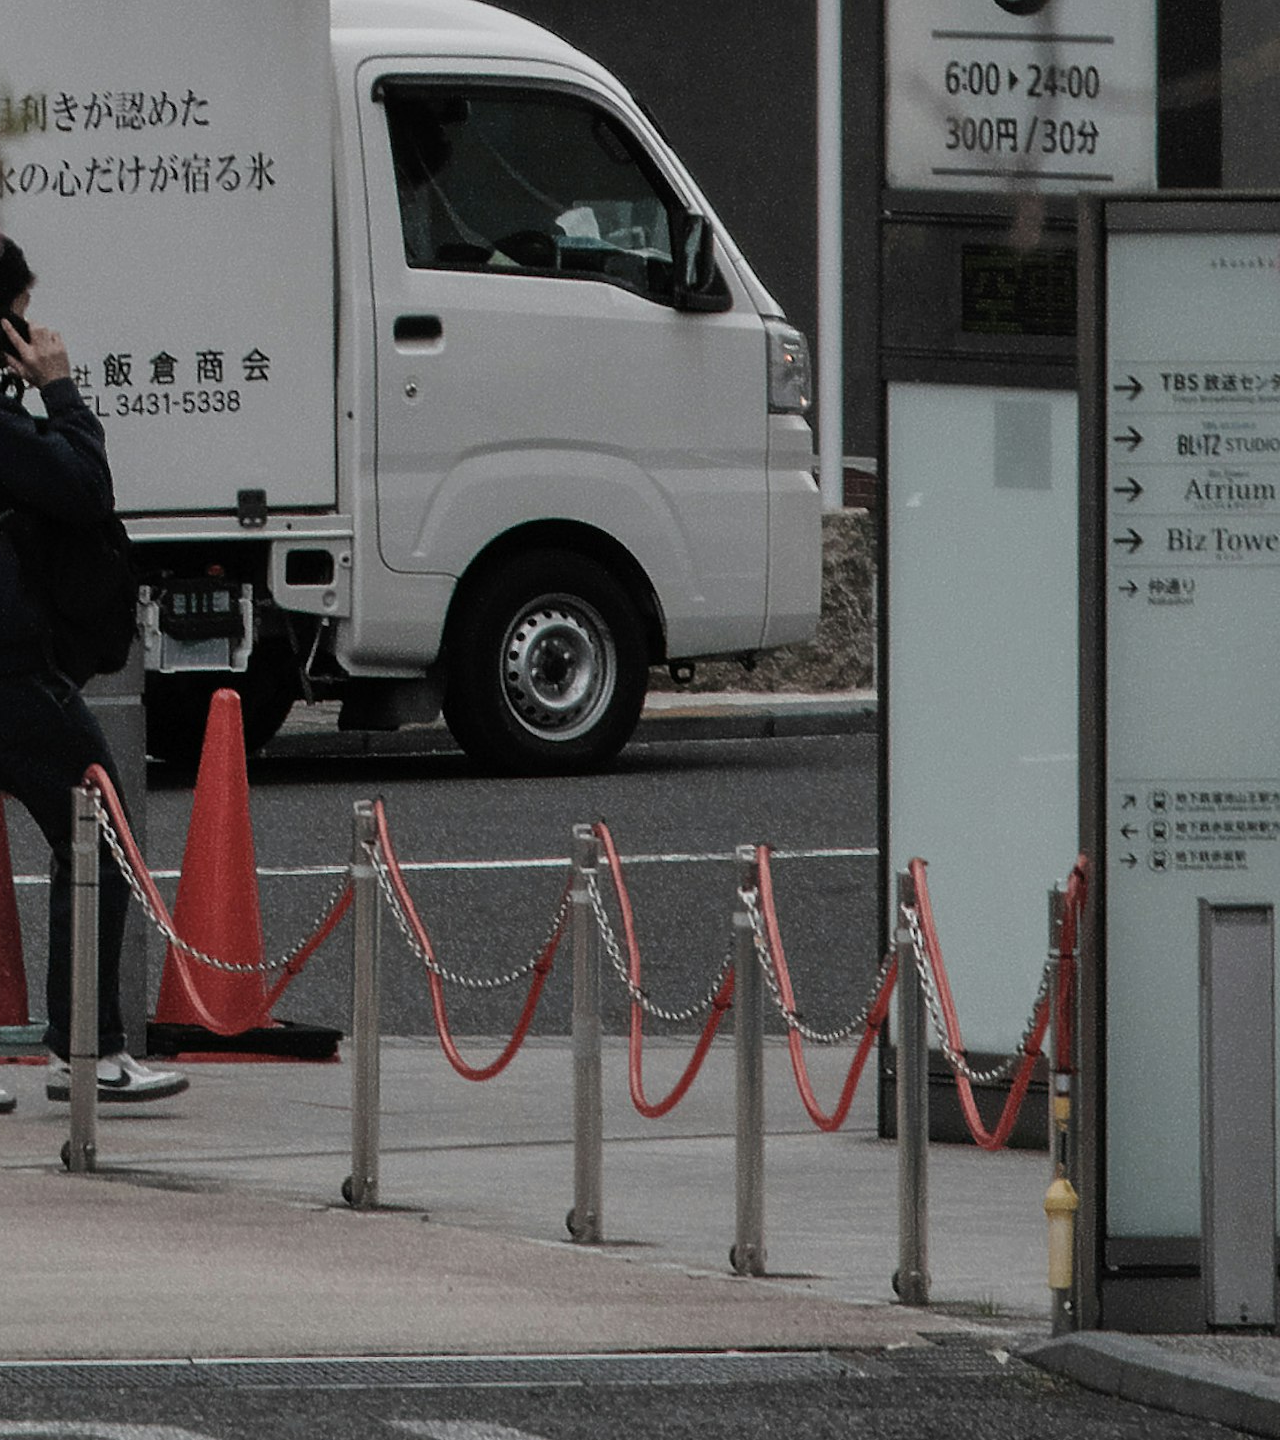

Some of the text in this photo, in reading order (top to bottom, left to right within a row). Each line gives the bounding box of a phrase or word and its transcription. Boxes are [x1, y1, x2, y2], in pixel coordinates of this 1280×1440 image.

[945, 62, 1100, 98] 6:00 24:00
[1160, 373, 1199, 391] TBS
[115, 390, 241, 417] 3431-5338
[1184, 478, 1276, 502] Atrium
[1167, 528, 1208, 552] Biz
